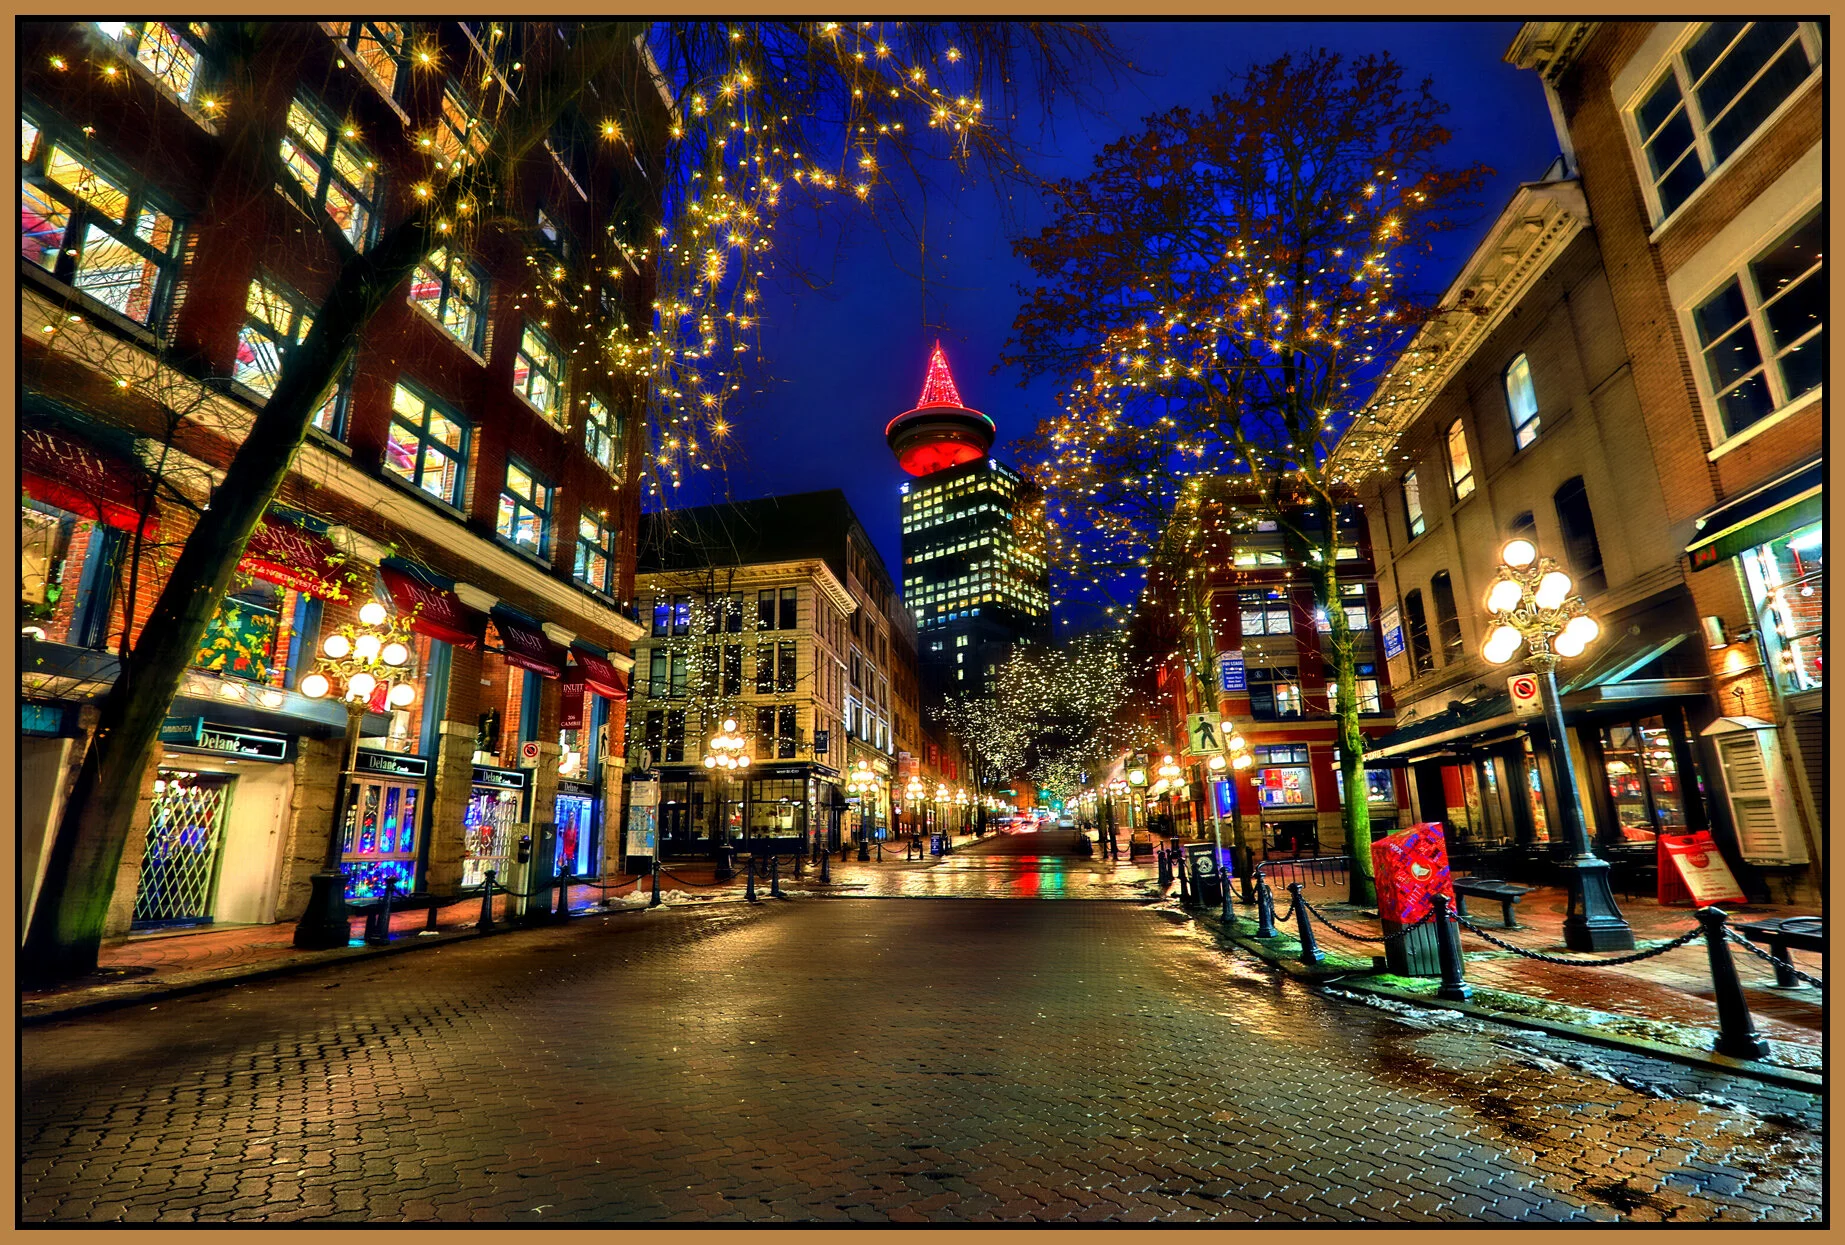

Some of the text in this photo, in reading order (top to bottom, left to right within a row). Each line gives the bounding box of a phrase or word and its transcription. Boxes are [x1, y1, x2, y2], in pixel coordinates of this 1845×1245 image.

[403, 582, 452, 613] INUIT
[507, 625, 543, 649] INUIT
[583, 656, 611, 678] INUIT
[563, 683, 585, 691] INUIT
[198, 732, 241, 752] Delané
[369, 755, 397, 771] Delané
[483, 771, 503, 783] Delané
[564, 782, 579, 792] Delané
